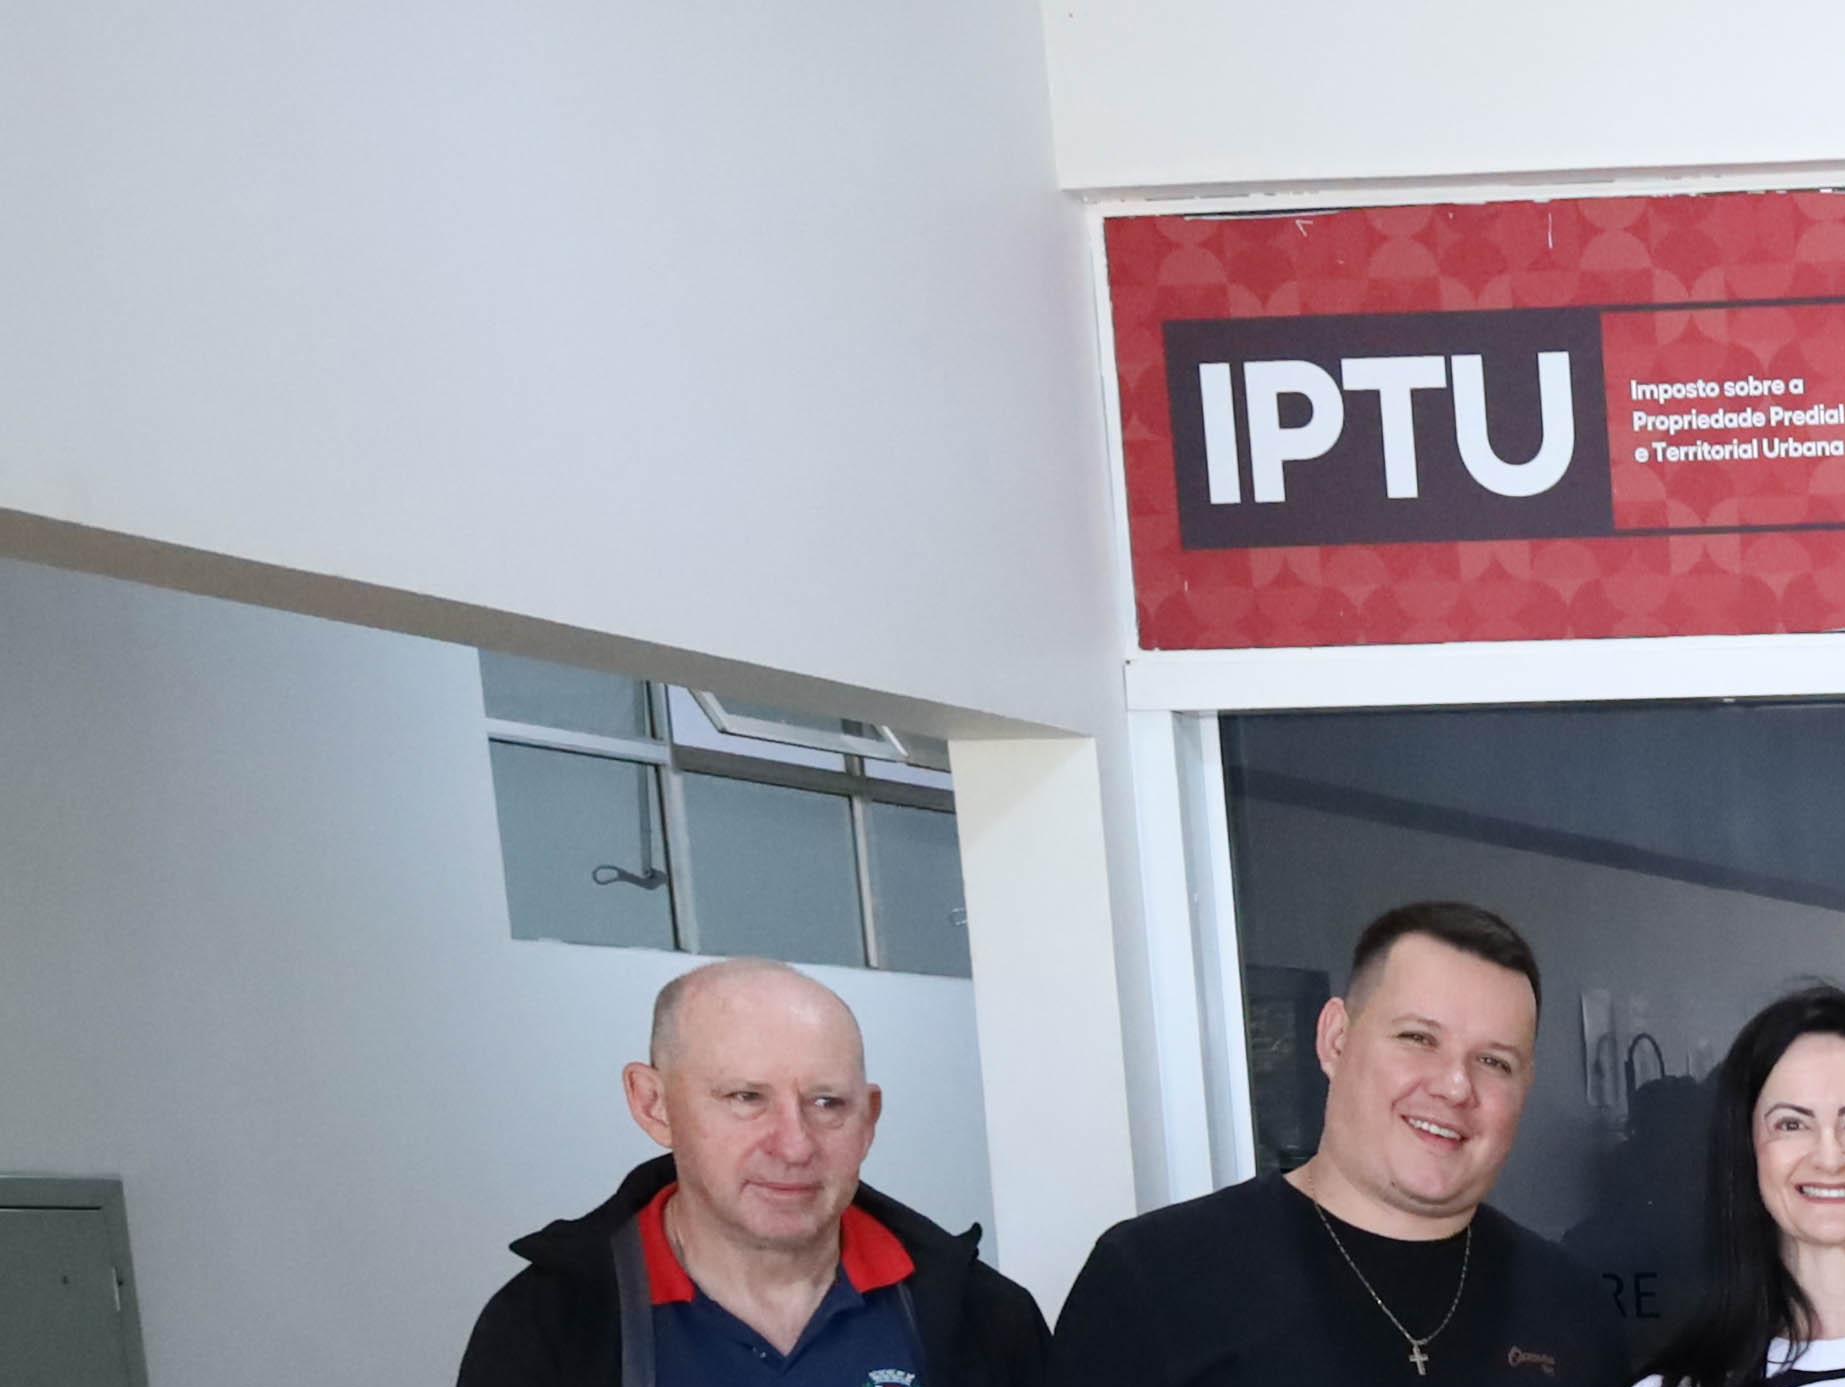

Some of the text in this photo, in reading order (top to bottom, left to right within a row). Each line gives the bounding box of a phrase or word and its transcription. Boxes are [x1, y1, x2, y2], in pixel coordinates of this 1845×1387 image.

[1630, 375, 1804, 404] Imposto sobre a
[1198, 351, 1575, 505] IPTU
[1632, 404, 1845, 435] Propriedade Predial
[1634, 437, 1844, 462] e Territorial Urbana
